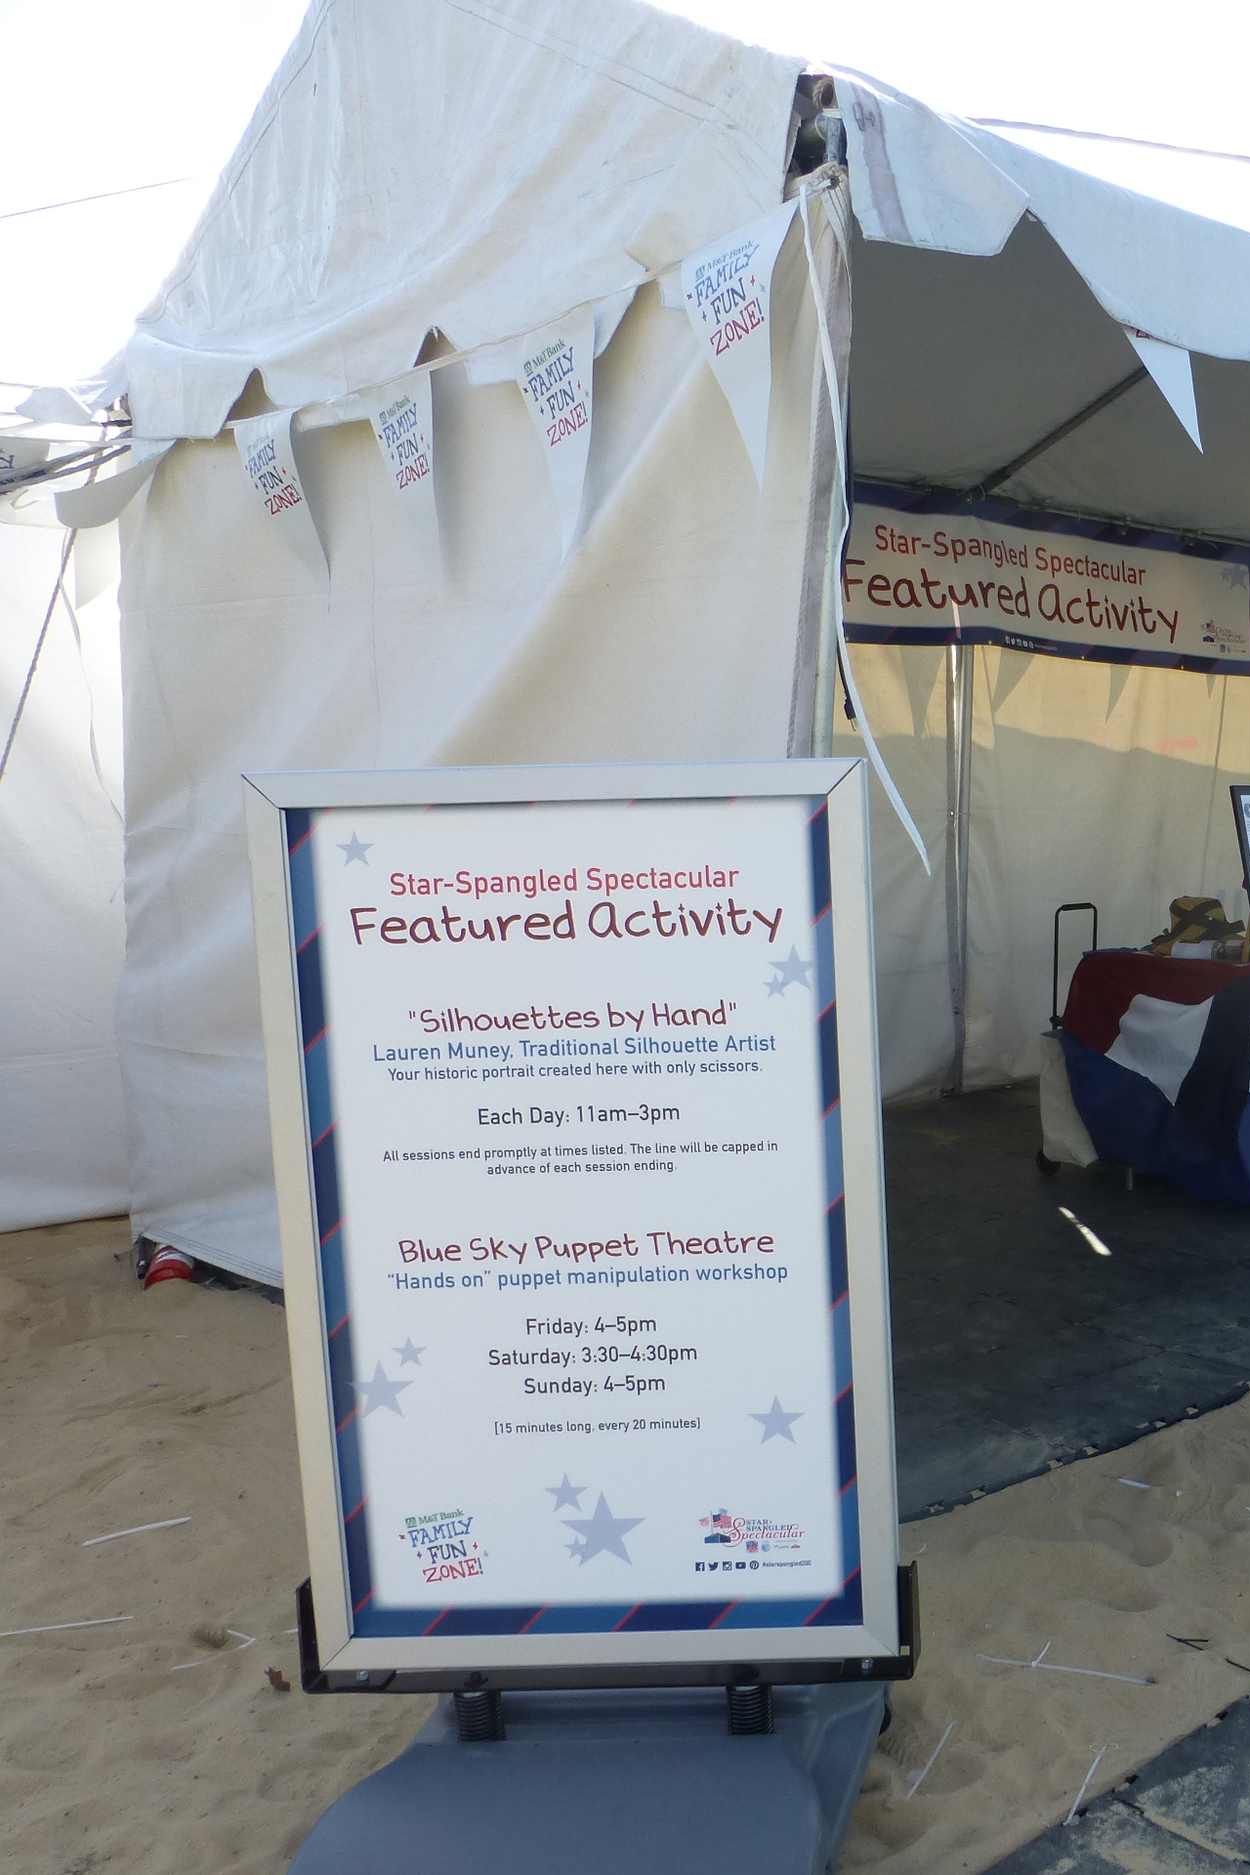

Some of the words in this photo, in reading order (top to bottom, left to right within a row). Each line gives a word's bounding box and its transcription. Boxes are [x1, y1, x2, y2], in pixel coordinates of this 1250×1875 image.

[729, 240, 753, 259] Bank
[695, 244, 760, 308] FAMILY
[710, 277, 746, 325] FUN
[710, 297, 765, 356] ZONE!
[546, 339, 567, 357] Bank
[528, 346, 574, 402] FAMILY
[546, 381, 575, 420] FUN
[383, 403, 417, 448] FAMILY
[547, 401, 588, 446] ZONE!
[248, 439, 276, 478] FAMILY
[396, 433, 418, 466] FUN
[258, 466, 284, 495] FUN
[396, 452, 430, 489] ZONE!
[264, 483, 302, 515] ZONE!
[874, 524, 1029, 569] Star-Spangled
[1035, 546, 1147, 586] Spectacular
[843, 558, 1031, 619] Featured
[390, 868, 577, 900] Star-Spangled
[587, 865, 739, 896] Spectacular
[350, 899, 576, 945] Featured
[607, 1002, 645, 1032] by
[373, 1045, 441, 1061] Lauren
[448, 1042, 513, 1062] Muney,
[519, 1038, 619, 1057] Traditional
[624, 1037, 718, 1054] Silhouette
[725, 1035, 776, 1052] Artist
[388, 1068, 420, 1081] Your
[425, 1066, 478, 1080] historic
[482, 1064, 534, 1082] portrait
[539, 1062, 591, 1076] created
[596, 1062, 628, 1075] here
[632, 1061, 661, 1074] with
[667, 1060, 696, 1076] only
[700, 1059, 762, 1073] scissors.
[478, 1107, 522, 1125] Each
[530, 1107, 569, 1127] Day:
[383, 1150, 399, 1162] All
[402, 1149, 455, 1161] sessions
[459, 1148, 480, 1159] end
[484, 1146, 537, 1161] promptly
[540, 1146, 551, 1157] at
[555, 1145, 588, 1156] times
[592, 1144, 626, 1155] listed.
[630, 1143, 651, 1154] The
[655, 1143, 676, 1154] line
[680, 1142, 701, 1153] will
[704, 1142, 718, 1152] be
[722, 1140, 764, 1154] capped
[768, 1140, 778, 1151] in
[487, 1164, 536, 1175] advance
[540, 1162, 550, 1173] of
[554, 1161, 581, 1173] each
[585, 1160, 630, 1172] session
[634, 1159, 677, 1173] ending.
[398, 1239, 461, 1263] Blue
[470, 1237, 527, 1265] Sky
[535, 1233, 639, 1263] Puppet
[646, 1230, 774, 1256] Theatre
[498, 1269, 561, 1291] puppet
[567, 1265, 689, 1287] manipulation
[695, 1263, 787, 1283] workshop
[526, 1318, 588, 1338] Friday:
[489, 1348, 575, 1368] Saturday:
[524, 1377, 597, 1397] Sunday:
[495, 1421, 512, 1435] [15
[516, 1422, 563, 1433] minutes
[567, 1421, 595, 1434] long,
[598, 1422, 630, 1433] every
[633, 1419, 646, 1430] 20
[650, 1417, 700, 1429] minutes]
[407, 1516, 473, 1548] FAMILY
[418, 1513, 438, 1525] M&T
[440, 1508, 464, 1521] Bank
[723, 1517, 805, 1548] Spectacular
[427, 1540, 467, 1565] FUN
[422, 1557, 483, 1583] ZONE!
